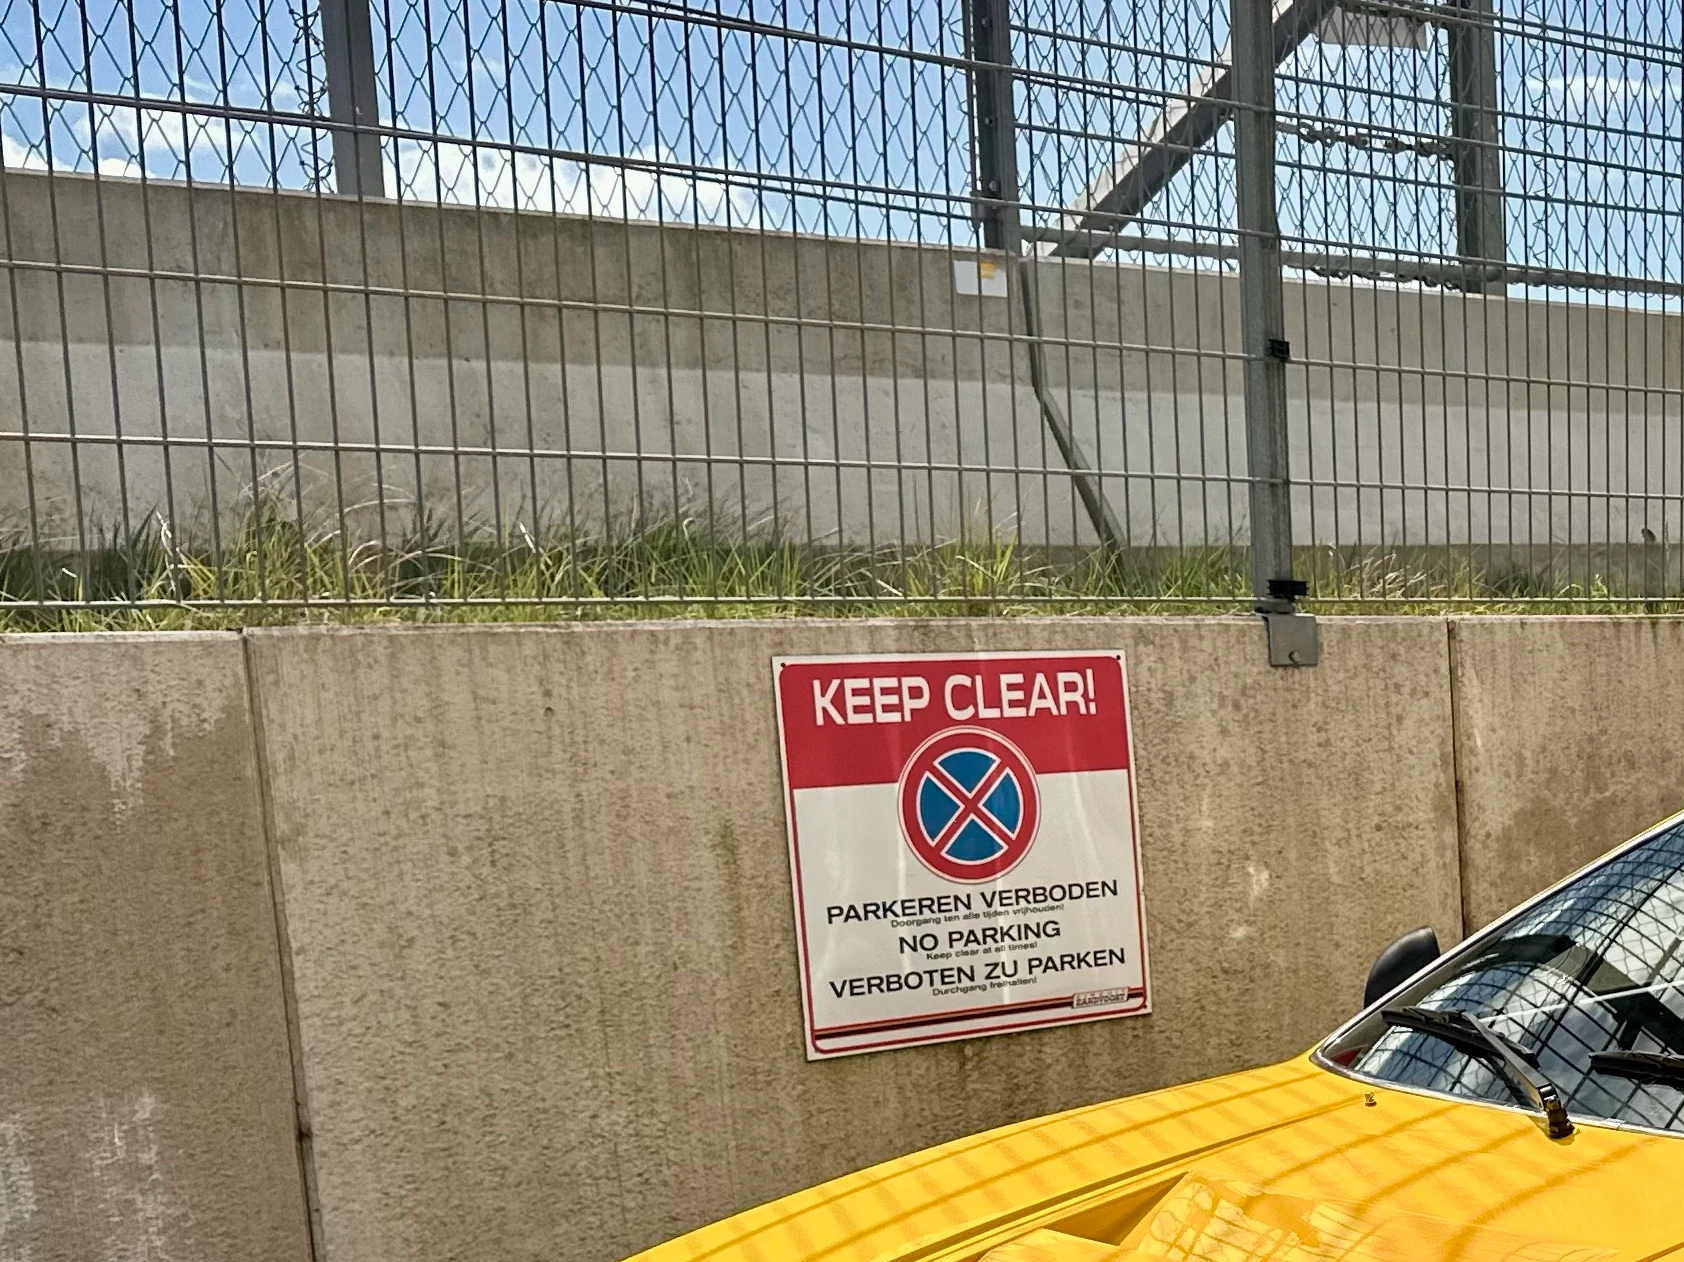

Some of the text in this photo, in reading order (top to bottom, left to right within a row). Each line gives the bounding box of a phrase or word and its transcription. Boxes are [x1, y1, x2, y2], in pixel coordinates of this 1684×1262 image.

[812, 668, 1097, 726] KEEP CLEAR!
[827, 879, 1119, 925] PARKEREN VERBODEN
[891, 915, 941, 929] Doorgang
[944, 914, 960, 922] ten
[983, 907, 1009, 921] tijden
[898, 920, 1061, 954] NO PARKING
[926, 951, 952, 962] Keep
[955, 946, 980, 958] clear
[829, 947, 1126, 998] VERBOTEN ZU PARKEN
[932, 981, 987, 997] Durchgang
